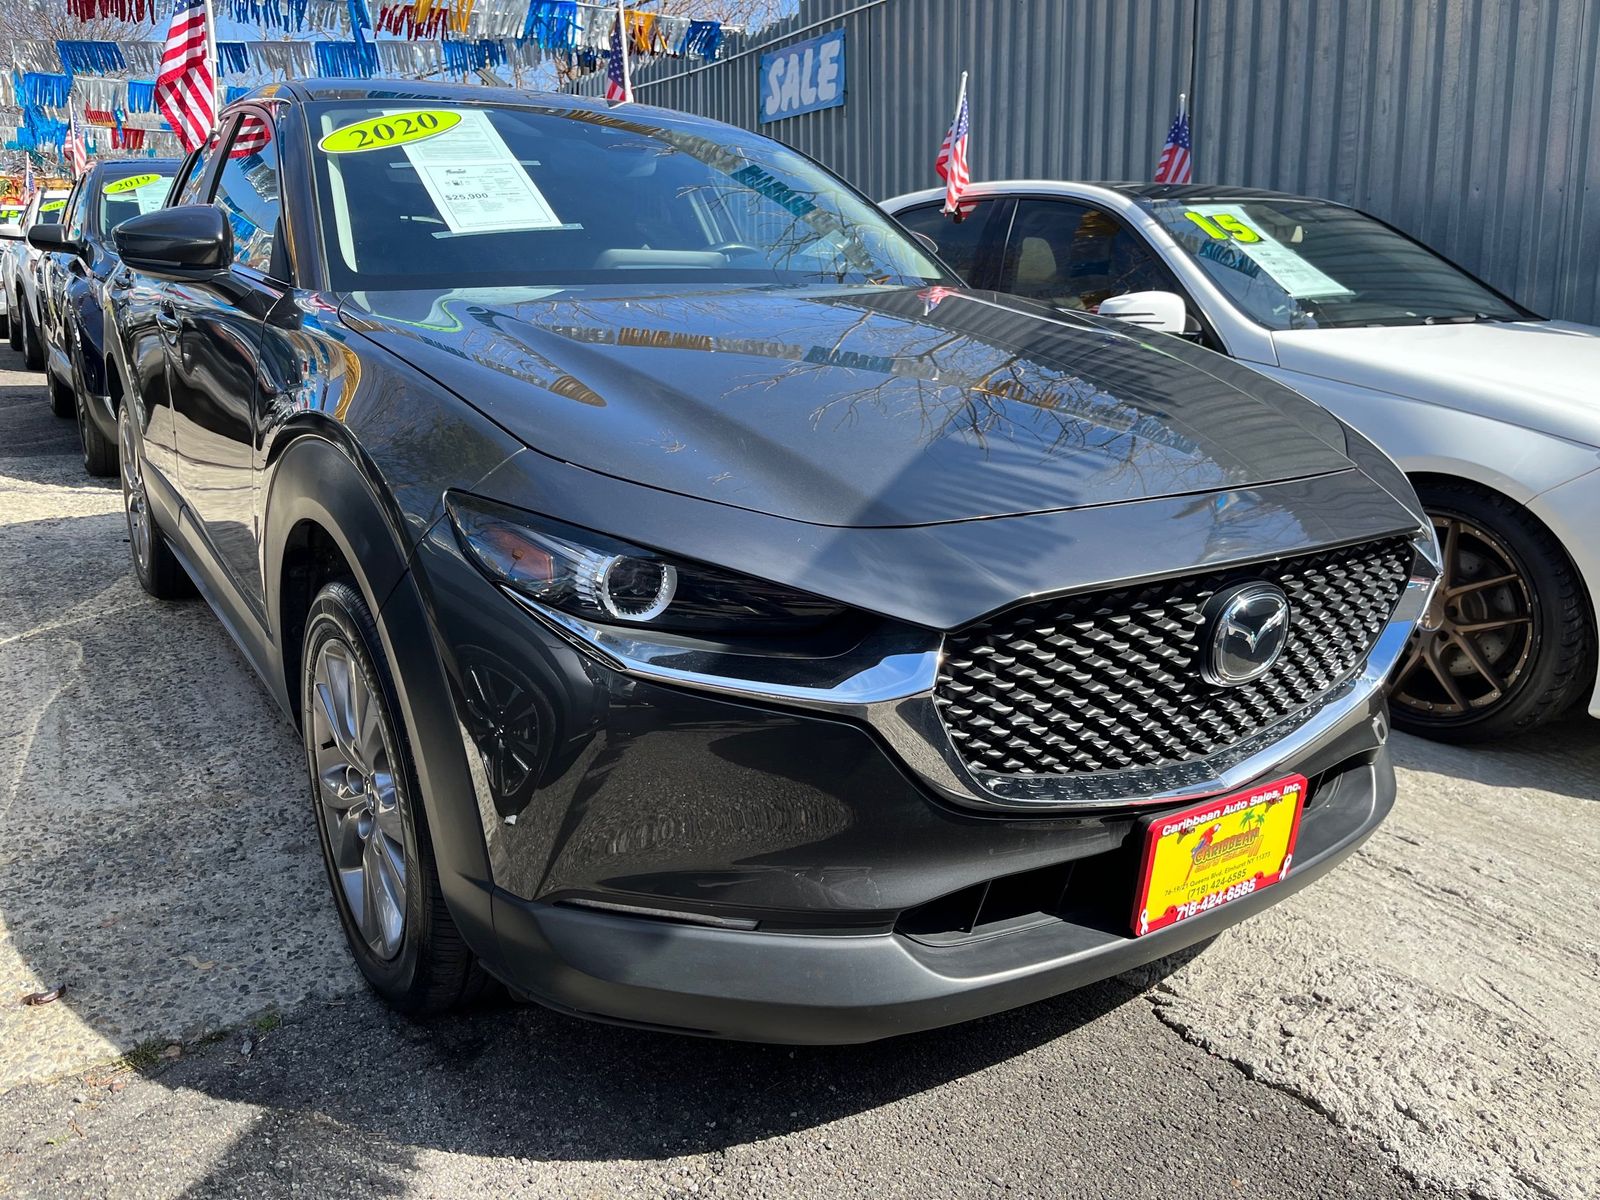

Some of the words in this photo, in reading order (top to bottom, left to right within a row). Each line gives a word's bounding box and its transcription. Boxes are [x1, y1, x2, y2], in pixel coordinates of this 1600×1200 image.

[765, 40, 840, 115] SALE
[349, 112, 438, 148] 2020
[116, 175, 150, 191] 2019
[445, 193, 488, 201] $25,900
[1184, 212, 1261, 243] 15
[1162, 809, 1220, 836] Caribbean
[1223, 800, 1247, 816] Auto
[1283, 782, 1301, 795] Inc.
[1194, 827, 1260, 865] CARIBBEAN
[1187, 883, 1209, 900] (718)
[1210, 868, 1247, 889] 424-6585
[1190, 876, 1209, 887] Queens
[1247, 857, 1255, 866] NY
[1175, 877, 1257, 921] 718-424-6585
